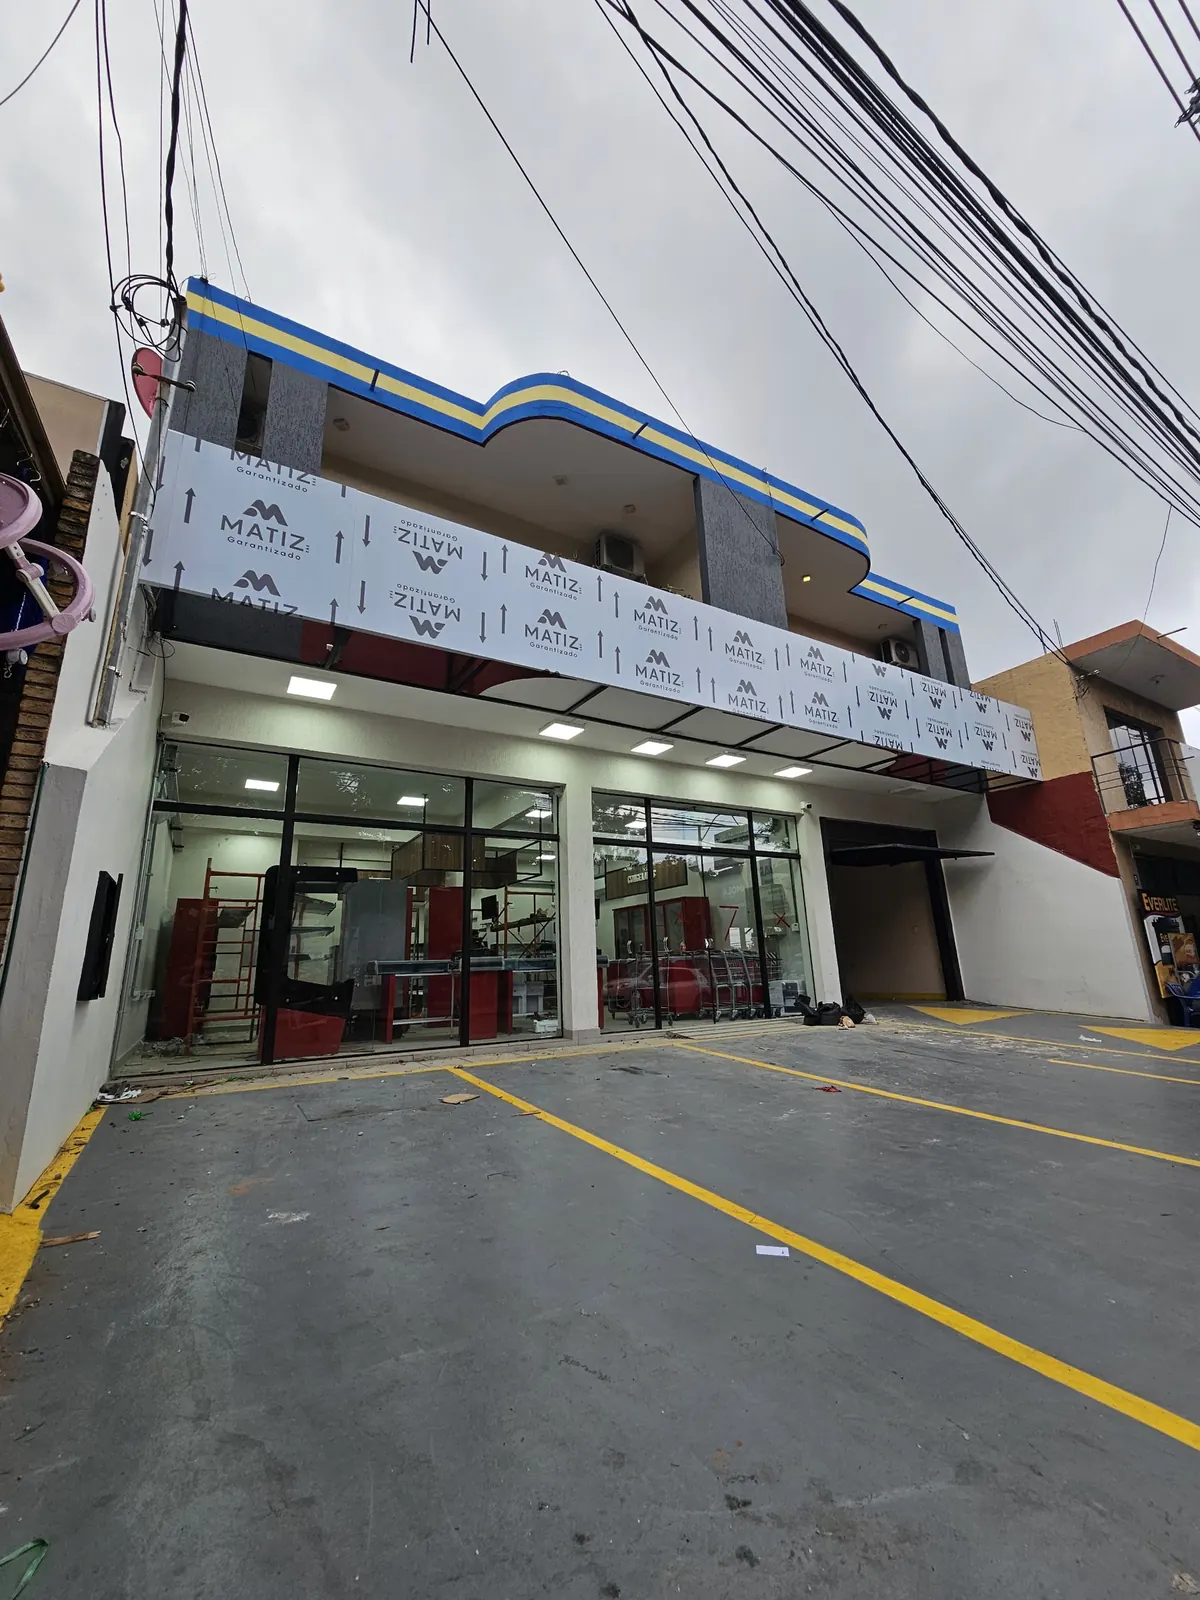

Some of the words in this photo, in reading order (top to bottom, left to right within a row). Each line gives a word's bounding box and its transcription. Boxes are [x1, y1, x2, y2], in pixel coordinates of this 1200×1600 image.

[236, 466, 309, 493] Garantizado
[220, 514, 307, 553] MATIZ
[400, 519, 458, 542] Garantizado
[227, 536, 301, 561] Garantizado
[397, 527, 463, 560] MATIZ
[525, 565, 579, 594] MATIZ
[396, 583, 456, 604] Garantizado
[529, 582, 578, 601] Garantizado
[393, 591, 461, 622] MATIZ
[634, 609, 679, 634] MATIZ
[524, 624, 579, 651] MATIZ
[638, 625, 678, 641] Garantizado
[529, 642, 578, 658] Garantizado
[725, 643, 763, 664] MATIZ
[635, 664, 681, 687] MATIZ
[800, 658, 833, 677] MATIZ
[640, 680, 681, 694] Garantizado
[922, 682, 947, 698] MATIZ
[728, 693, 767, 714] MATIZ
[869, 691, 898, 708] MATIZ
[804, 704, 838, 723] MATIZ
[927, 722, 953, 738] MATIZ
[975, 726, 998, 740] MATIZ
[1142, 892, 1179, 911] EVERLITE
